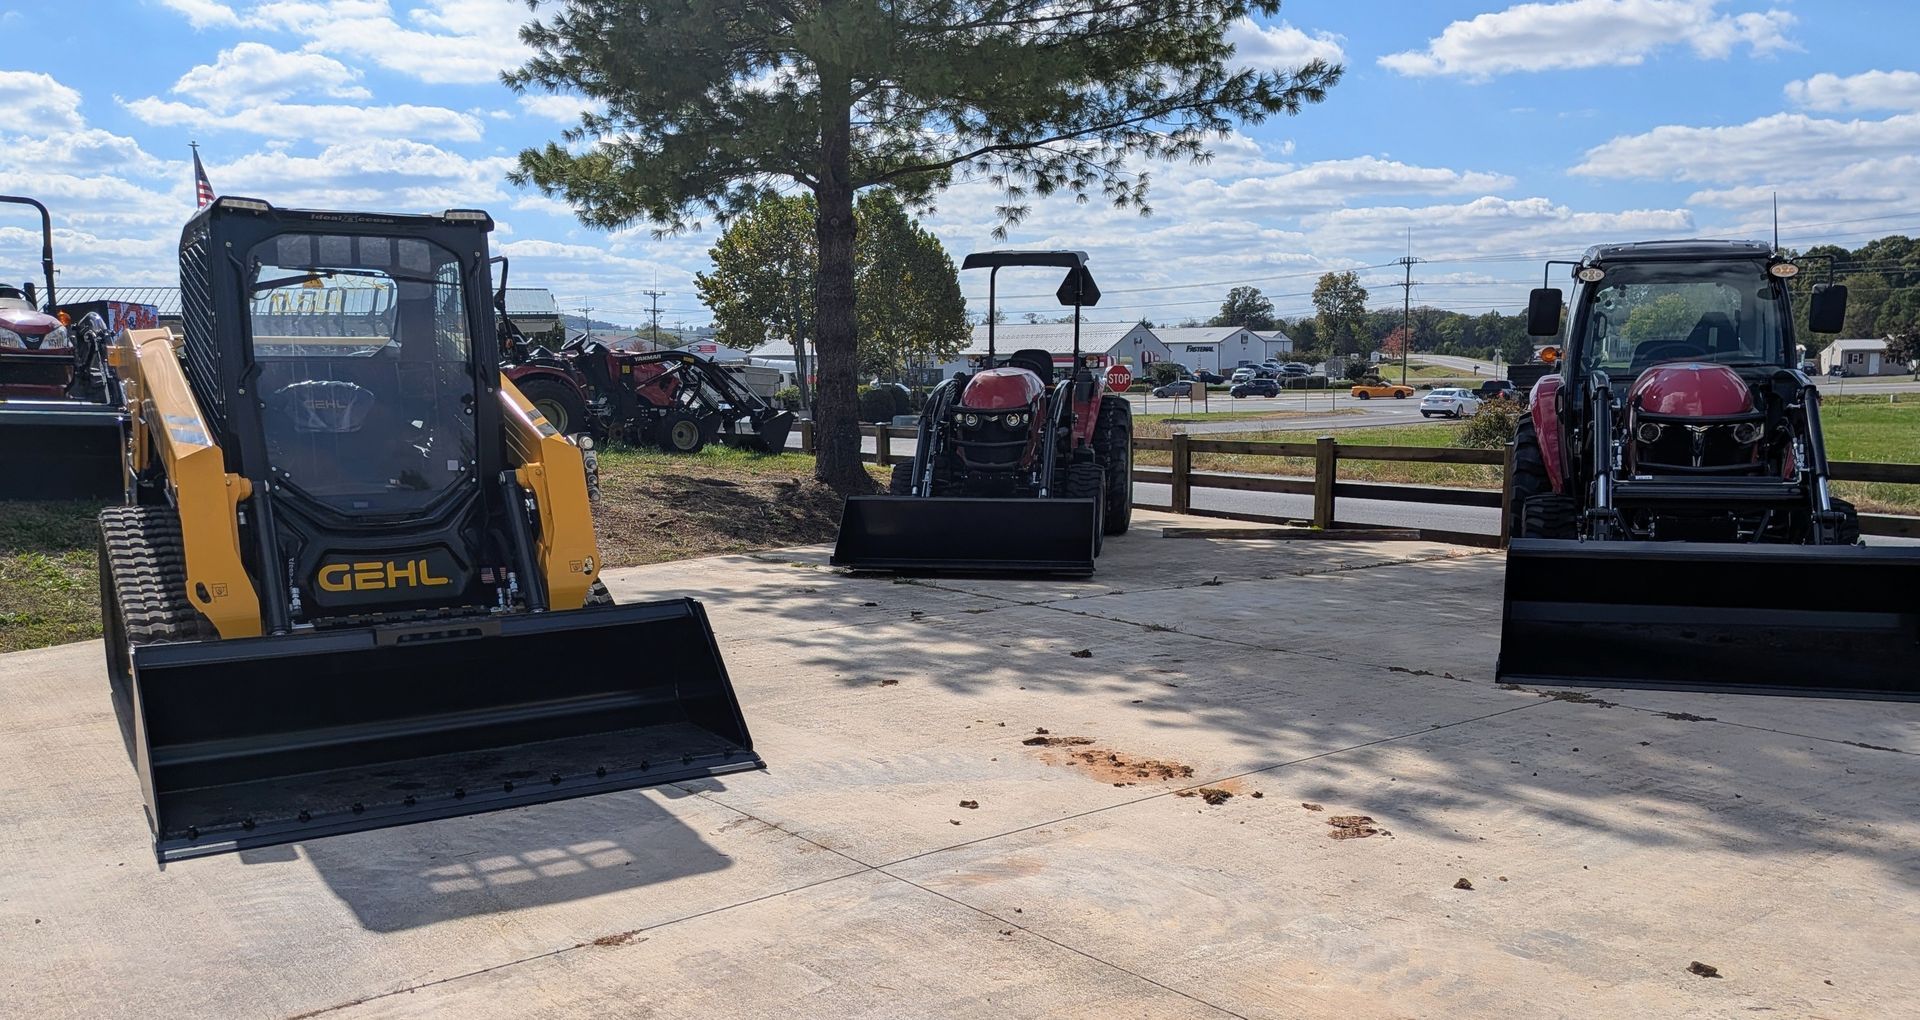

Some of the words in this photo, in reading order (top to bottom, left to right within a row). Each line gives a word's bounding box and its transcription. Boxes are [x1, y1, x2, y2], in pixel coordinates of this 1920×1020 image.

[634, 354, 662, 362] YANMAR
[1108, 373, 1130, 385] STOP
[304, 400, 347, 409] GEHL
[318, 559, 449, 592] GEHL
